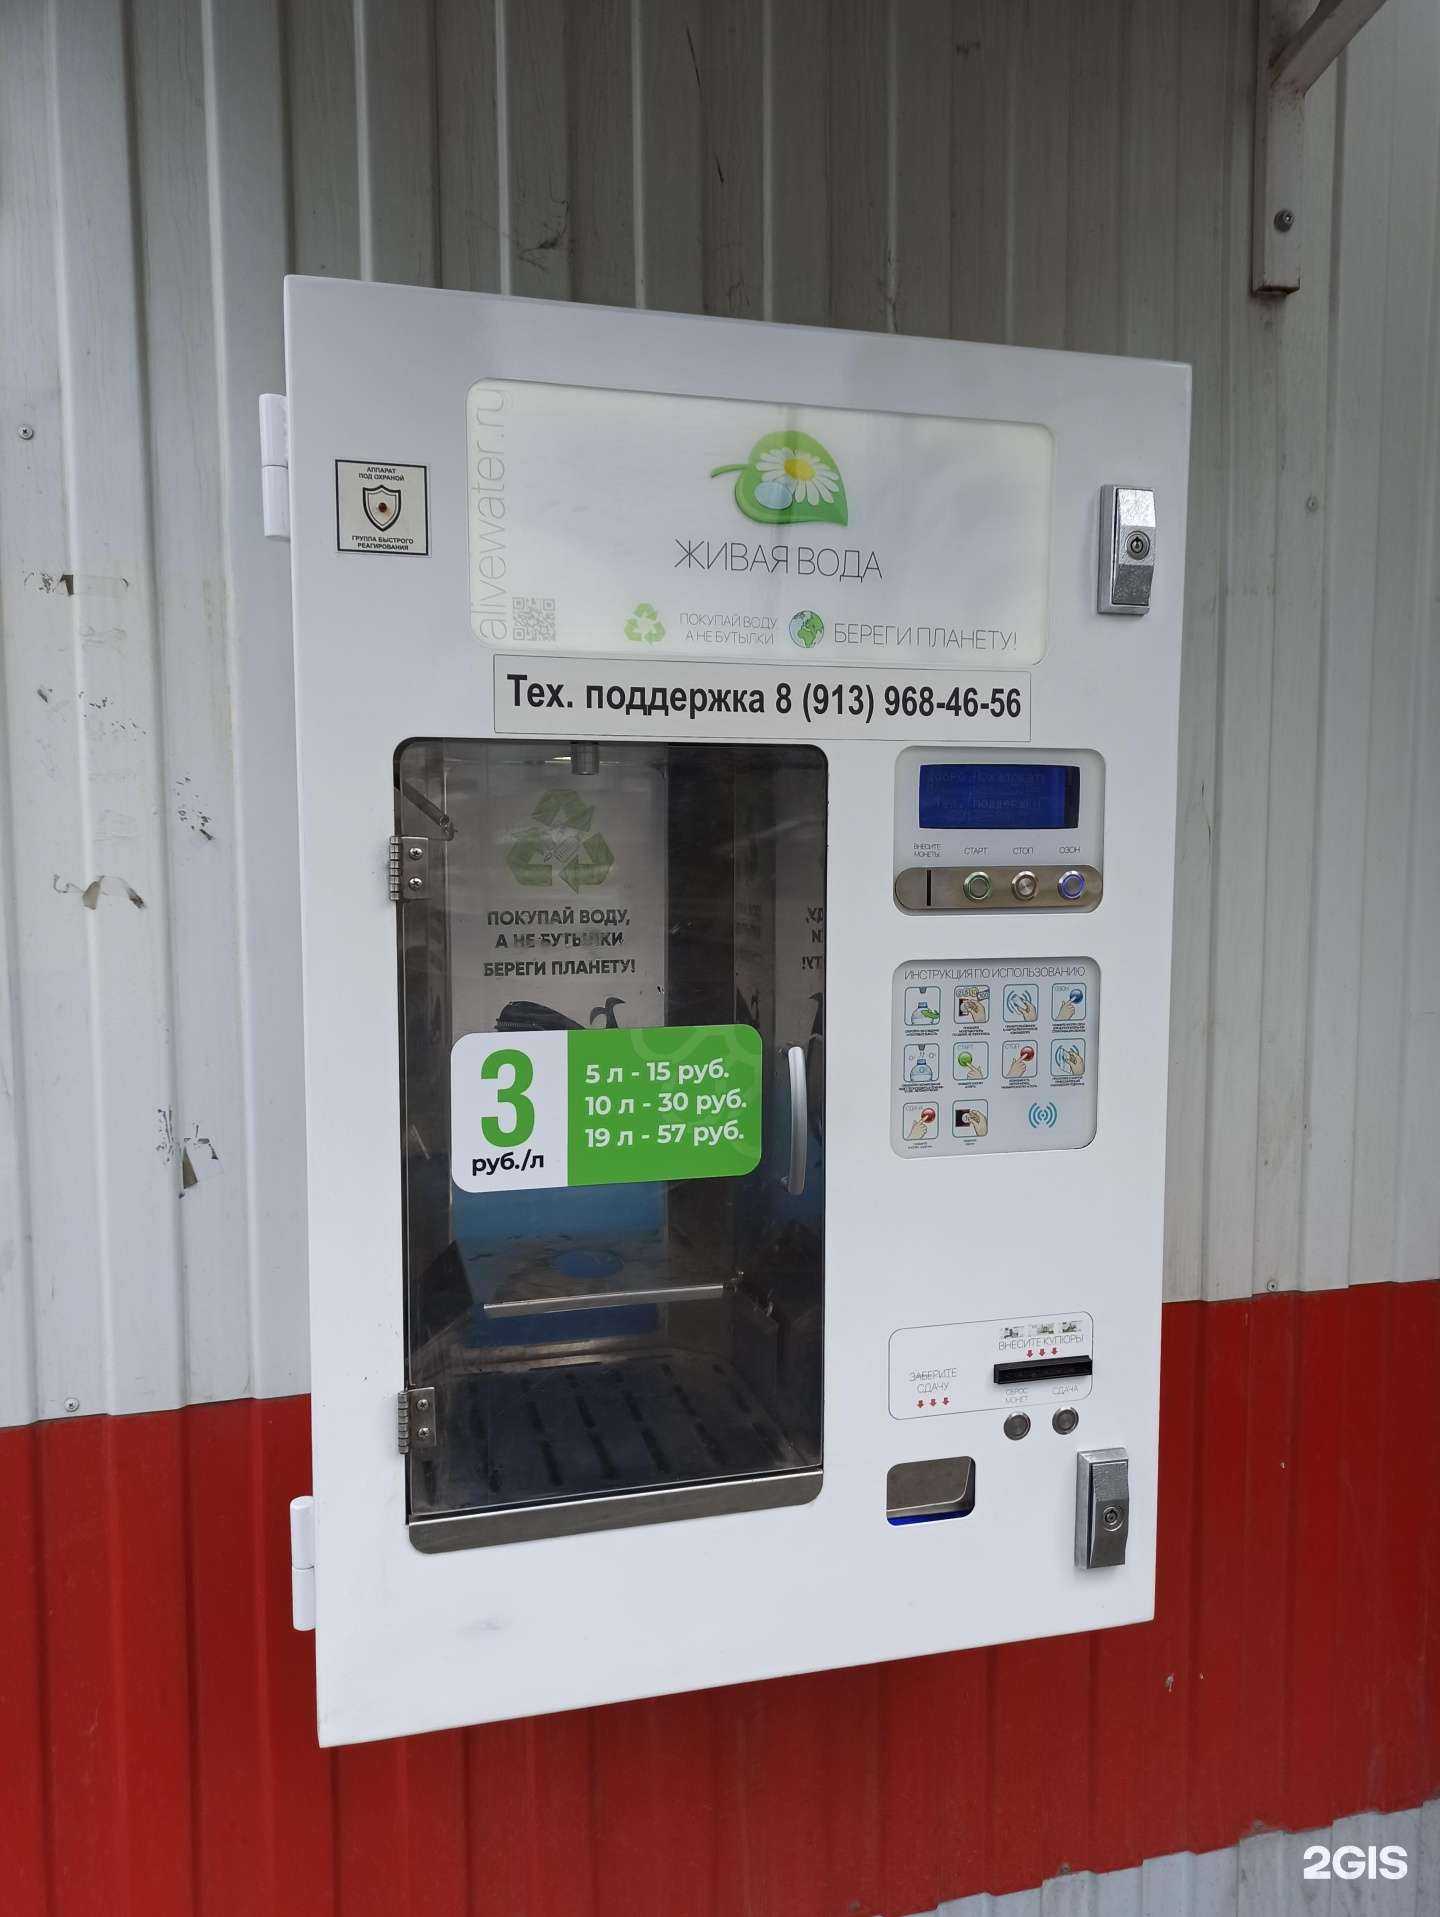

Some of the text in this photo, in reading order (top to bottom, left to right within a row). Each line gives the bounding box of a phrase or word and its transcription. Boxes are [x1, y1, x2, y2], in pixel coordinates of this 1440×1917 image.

[471, 387, 508, 641] alivewater.ru
[674, 538, 883, 583] ЖИВАЯ ВОДА
[680, 612, 778, 630] ПОКУПАЙ ВОДУ
[685, 630, 774, 646] А НЕ БУТЫЛКИ
[834, 622, 1017, 652] БЕРЕГИ ПЛАНЕТУ!
[506, 673, 1022, 724] Тех. поддержка 8 (913) 968-46-56
[963, 847, 988, 855] СТАРТ
[1012, 847, 1034, 855] СТОП
[1058, 846, 1081, 854] ОЗОН
[487, 906, 631, 926] ПОКУПАЙ ВОДУ,
[495, 933, 508, 948] А
[513, 933, 536, 948] НЕ
[483, 958, 637, 977] БЕРЕГИ ПЛАНЕТУ!
[904, 966, 1086, 980] ИНСТРУКЦИЯ ПО ИСПОЛЬЗОВАНИЮ
[585, 1064, 601, 1084] 5
[606, 1066, 624, 1083] л
[646, 1061, 671, 1082] 15
[678, 1058, 730, 1085] руб.
[480, 1048, 536, 1149] 3
[584, 1095, 612, 1116] 10
[618, 1098, 635, 1115] л
[657, 1092, 689, 1113] 30
[695, 1088, 748, 1115] руб.
[584, 1128, 610, 1148] 19
[616, 1129, 634, 1147] л
[656, 1123, 686, 1145] 57
[692, 1120, 745, 1147] руб.
[471, 1149, 545, 1177] руб./л
[999, 1335, 1084, 1351] ВНЕСИТЕ КУПЮРЫ
[908, 1367, 958, 1382] ЗАБЕРИТЕ
[916, 1381, 951, 1394] СДАЧУ
[1052, 1384, 1079, 1395] СДАЧА
